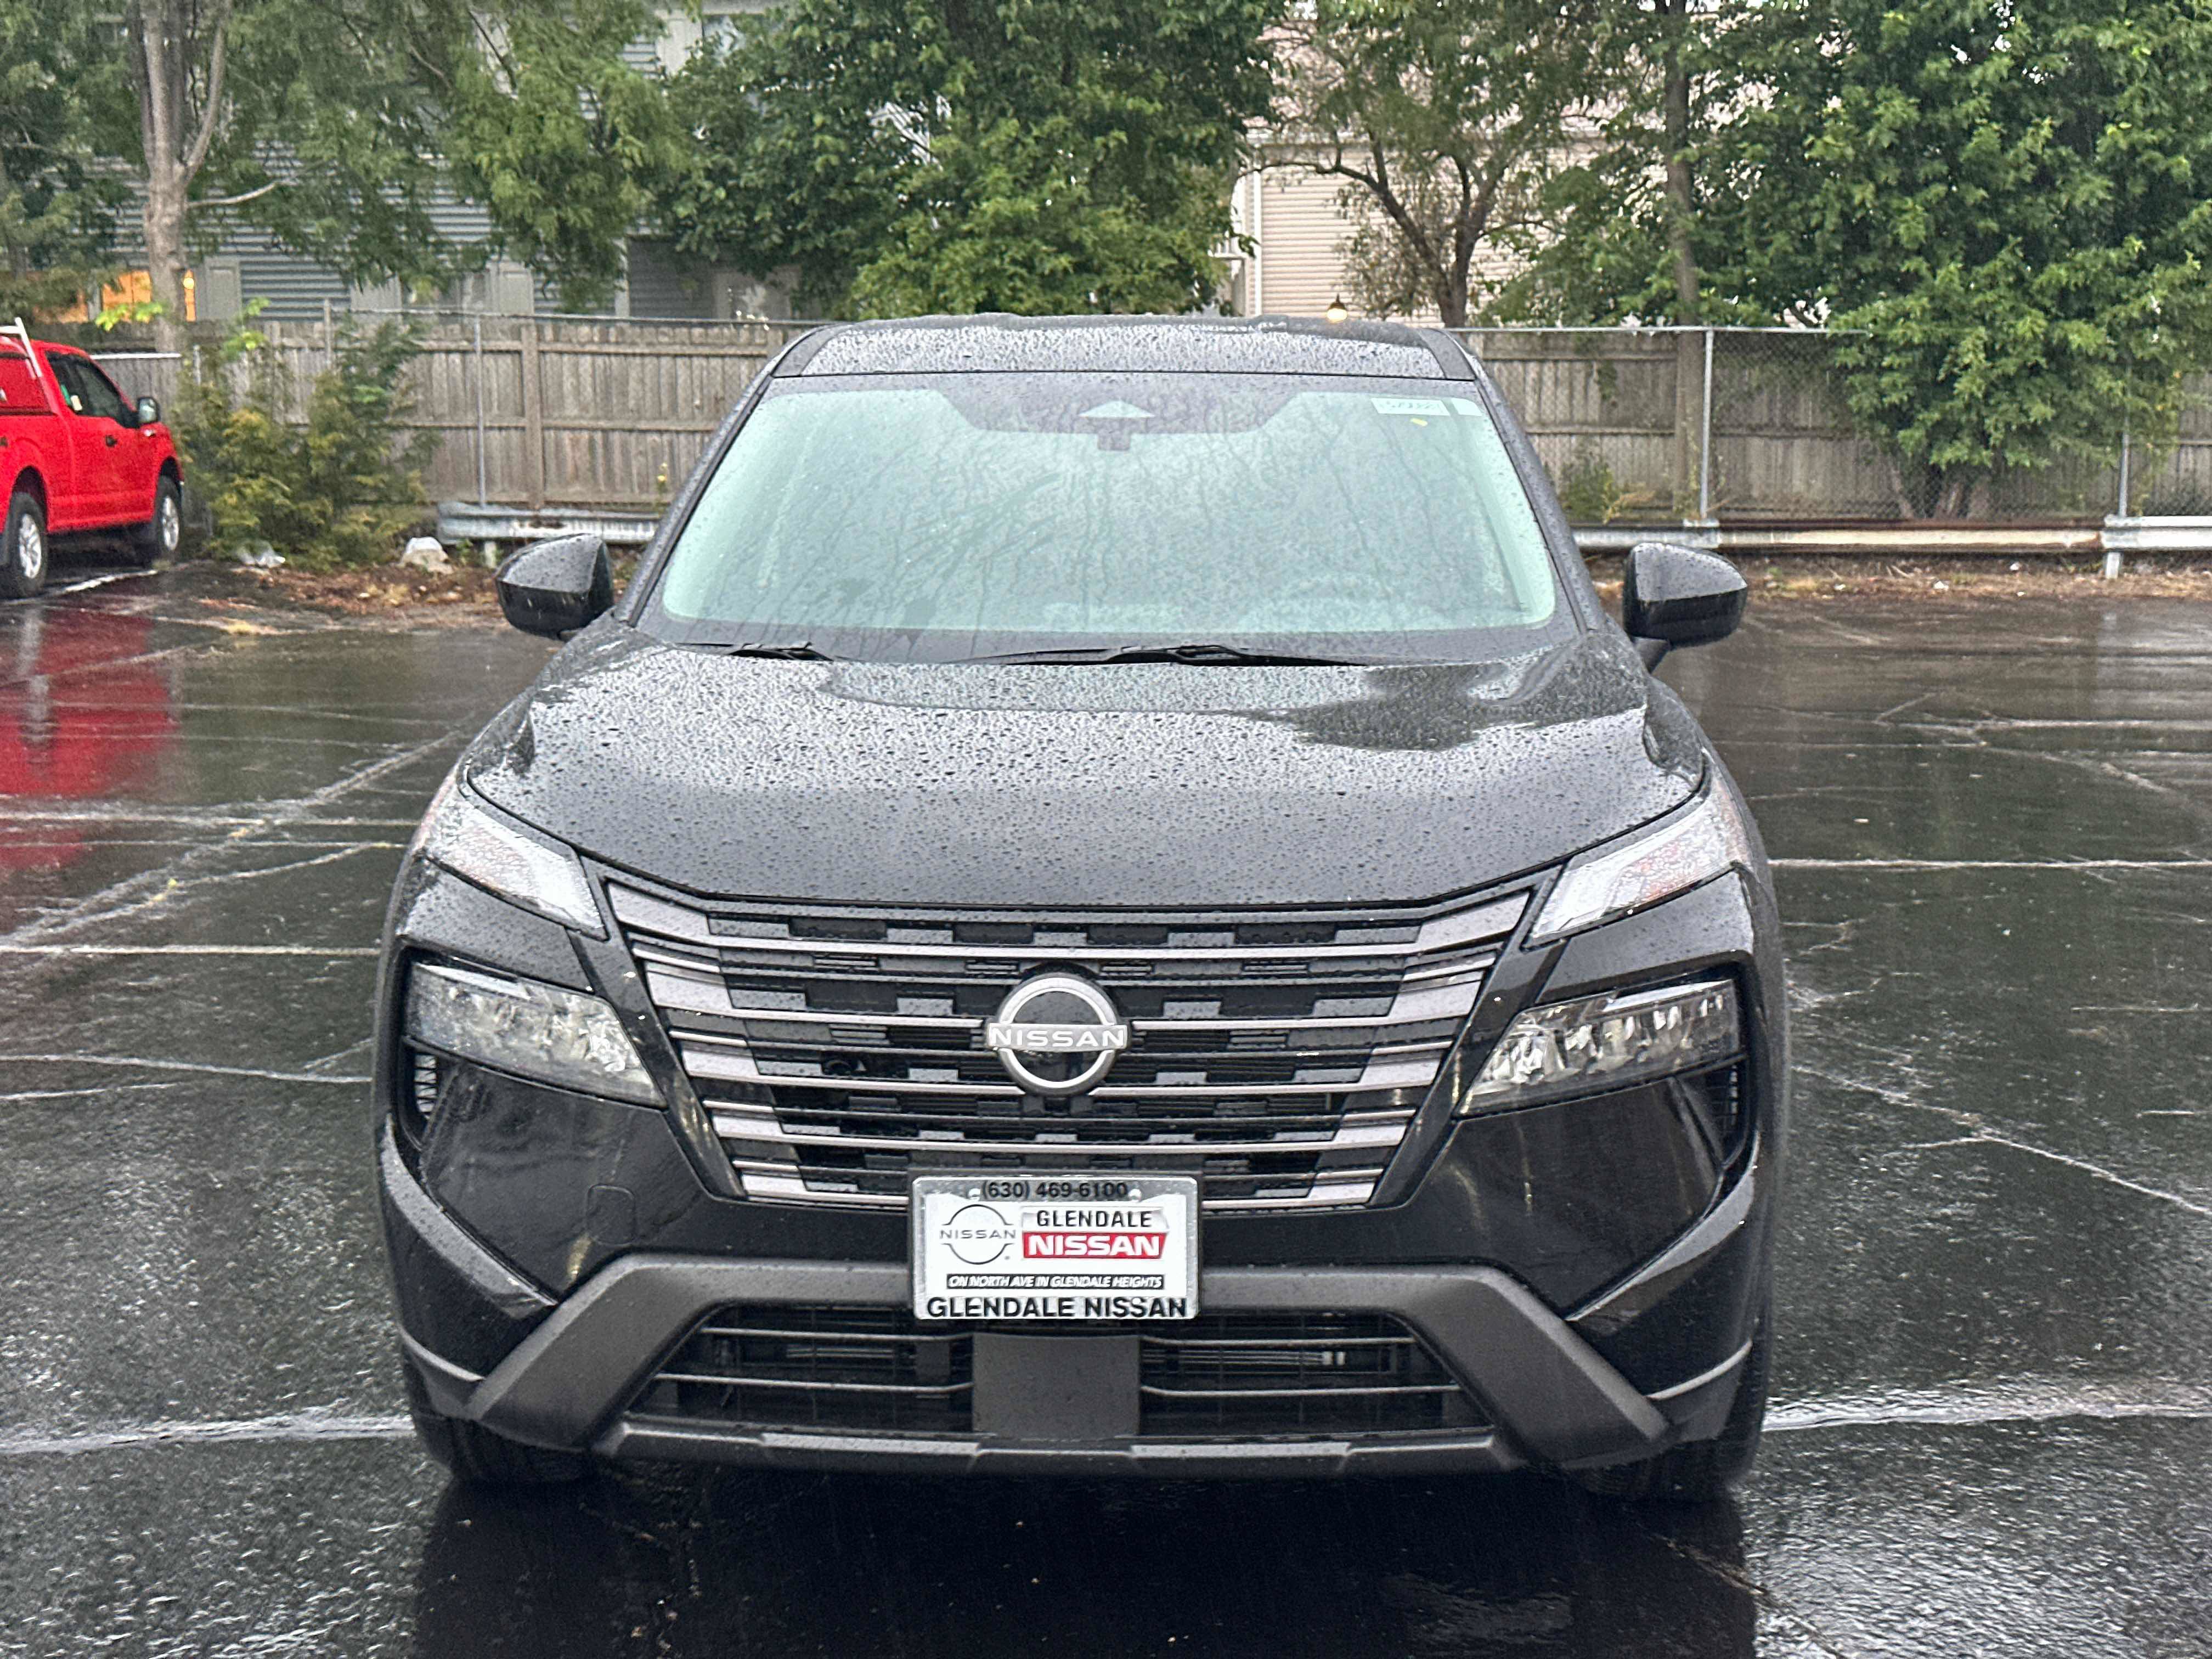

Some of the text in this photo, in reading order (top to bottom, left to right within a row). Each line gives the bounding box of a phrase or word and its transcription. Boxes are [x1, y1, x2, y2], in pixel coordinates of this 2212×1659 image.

[990, 1027, 1124, 1047] NISSAN
[982, 1181, 1128, 1199] (630) 469-6100
[1036, 1210, 1152, 1228] GLENDALE
[940, 1229, 1016, 1239] NISSAN
[1029, 1234, 1160, 1256] NISSAN
[948, 1276, 1163, 1288] ON NORTH AVE IN GLENDALE HEIGHTS
[927, 1296, 1187, 1317] GLENDALE NISSAN
